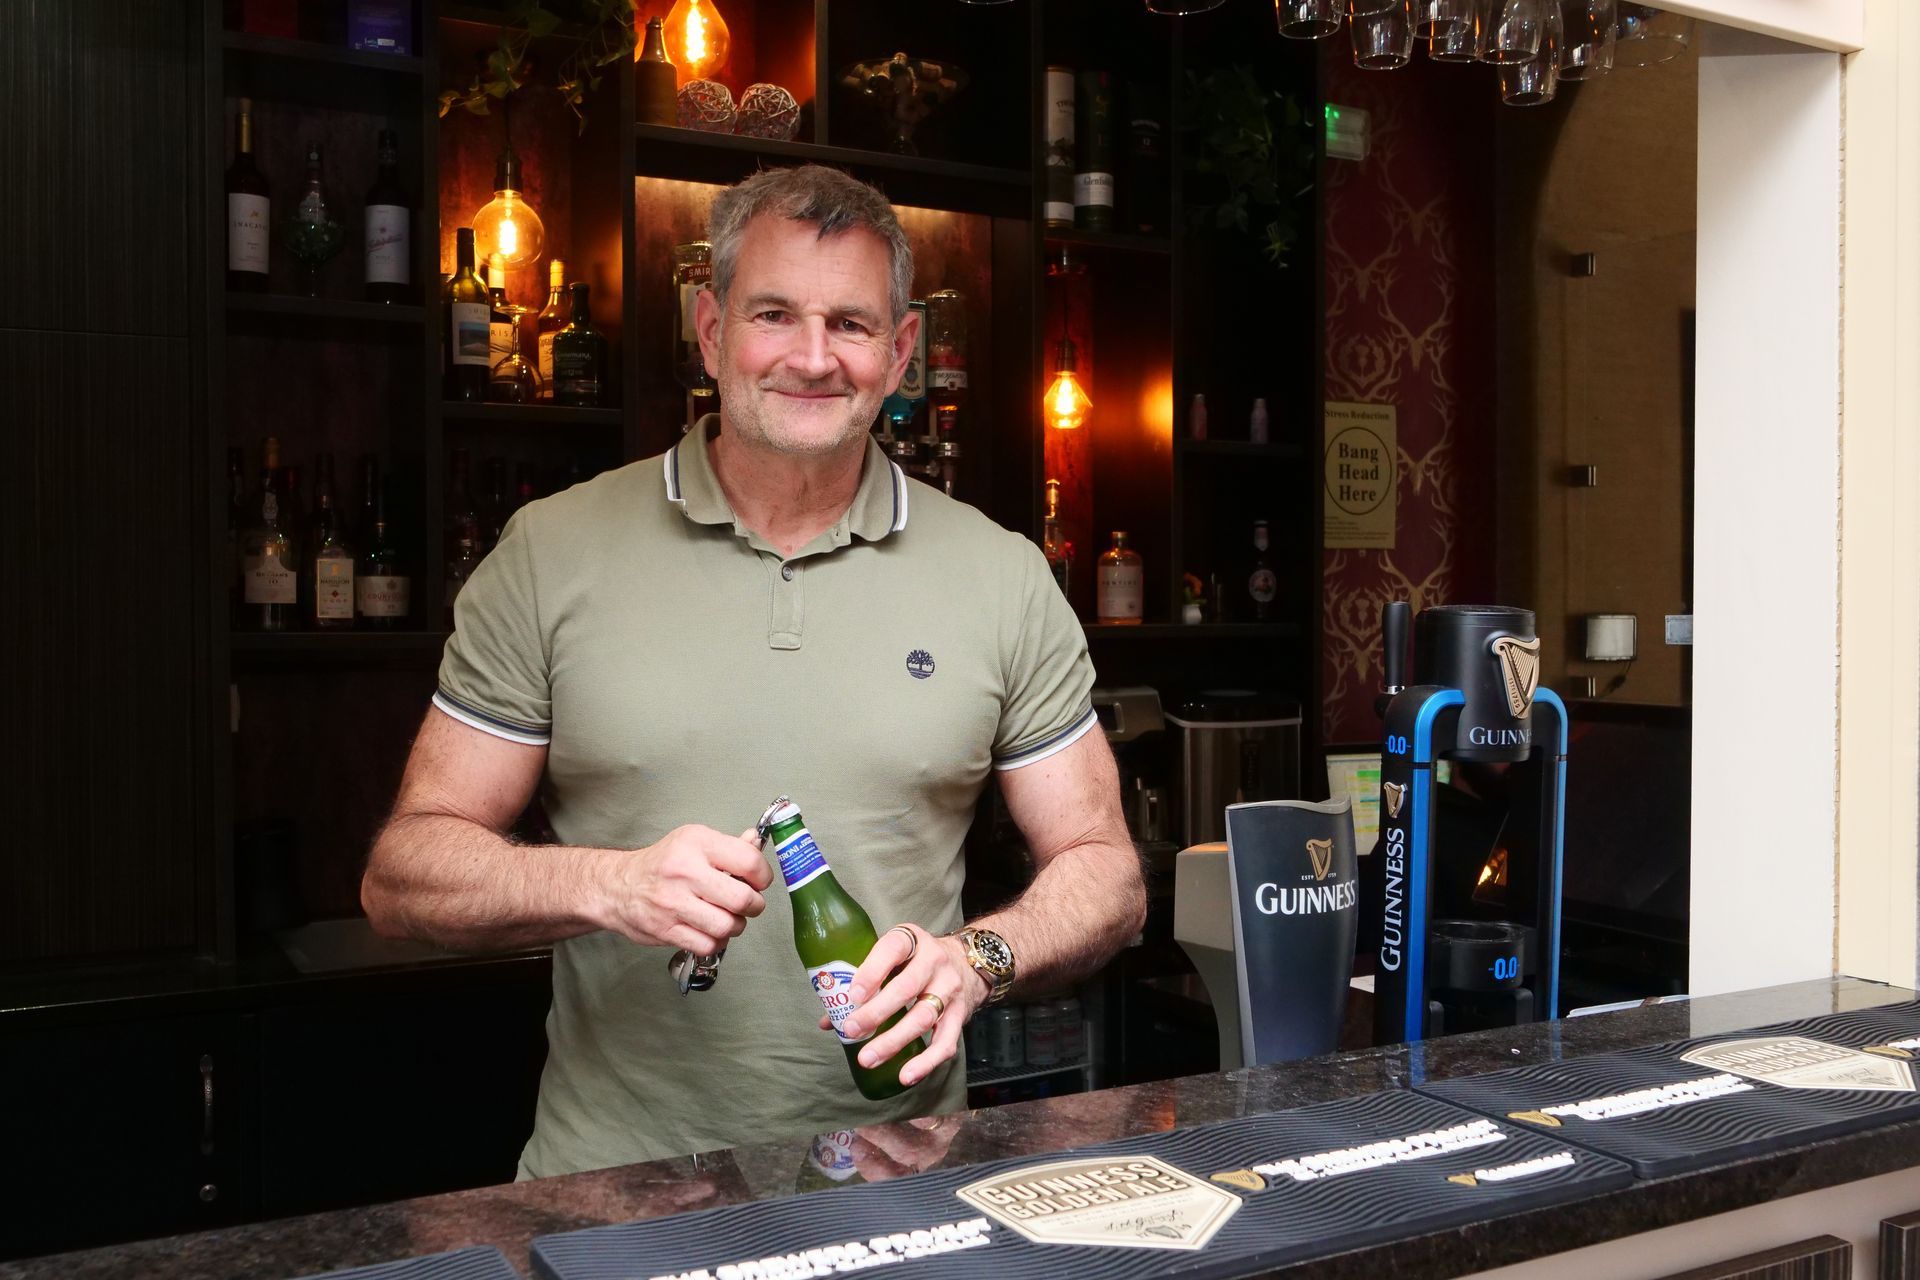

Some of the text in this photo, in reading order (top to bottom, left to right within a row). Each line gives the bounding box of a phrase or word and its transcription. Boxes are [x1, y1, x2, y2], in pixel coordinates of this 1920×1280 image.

[1325, 410, 1390, 421] Stress Reduction
[1338, 442, 1379, 463] Bang
[1338, 464, 1380, 482] Head
[1338, 485, 1377, 502] Here
[1255, 882, 1355, 915] GUINNESS
[1381, 827, 1405, 971] GUINNESS
[818, 992, 850, 1009] ERO
[1696, 1040, 1821, 1066] GUINNESS
[977, 1162, 1164, 1205] GUINNESS
[1004, 1188, 1130, 1220] GOLDEN
[1132, 1174, 1190, 1197] ALE
